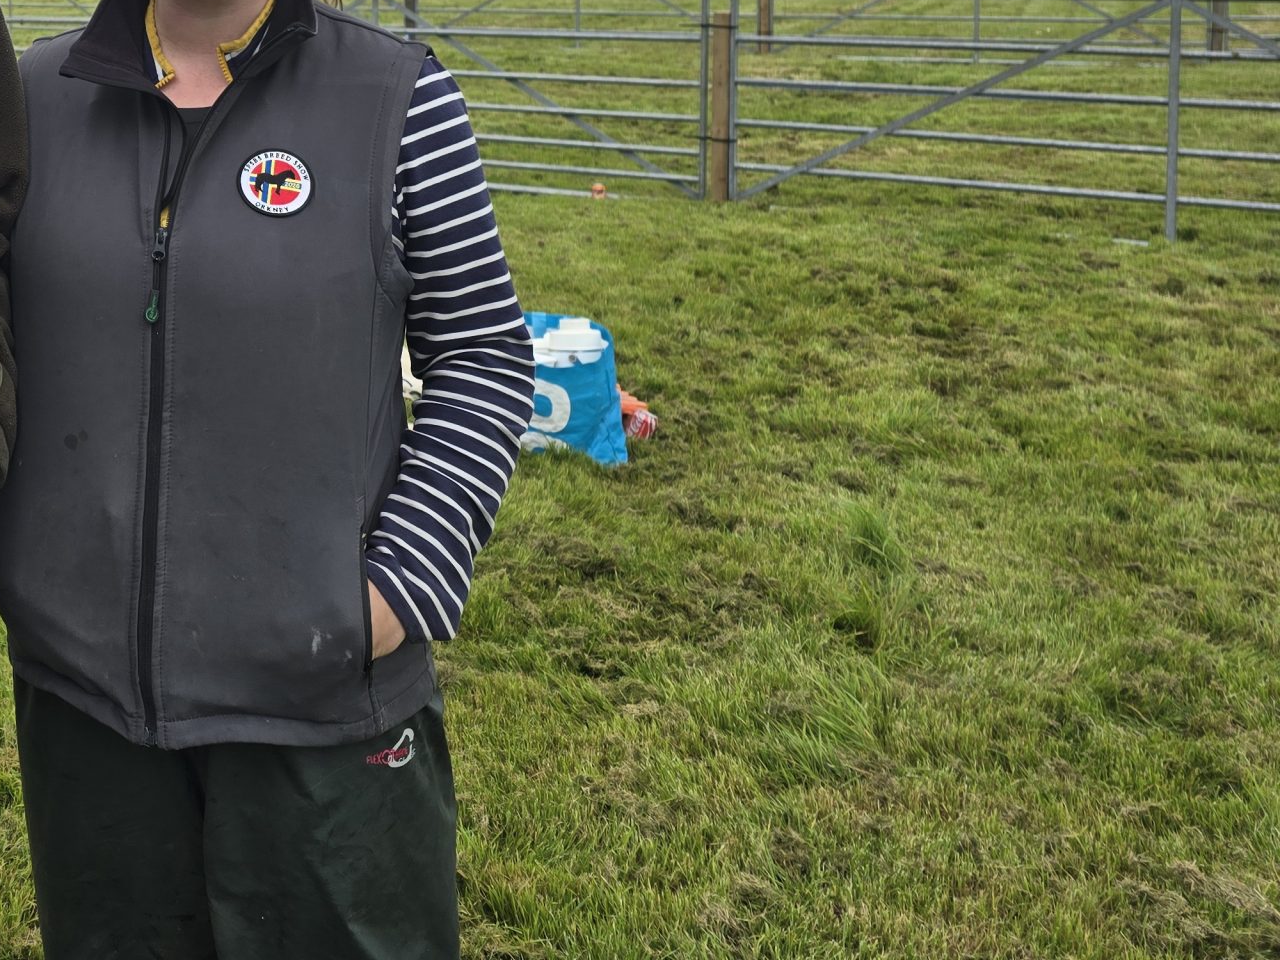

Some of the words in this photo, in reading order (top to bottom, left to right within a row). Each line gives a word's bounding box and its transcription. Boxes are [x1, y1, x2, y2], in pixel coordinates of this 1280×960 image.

[264, 152, 292, 162] BREED
[293, 160, 309, 181] SHOW
[255, 202, 289, 212] ORKNEY
